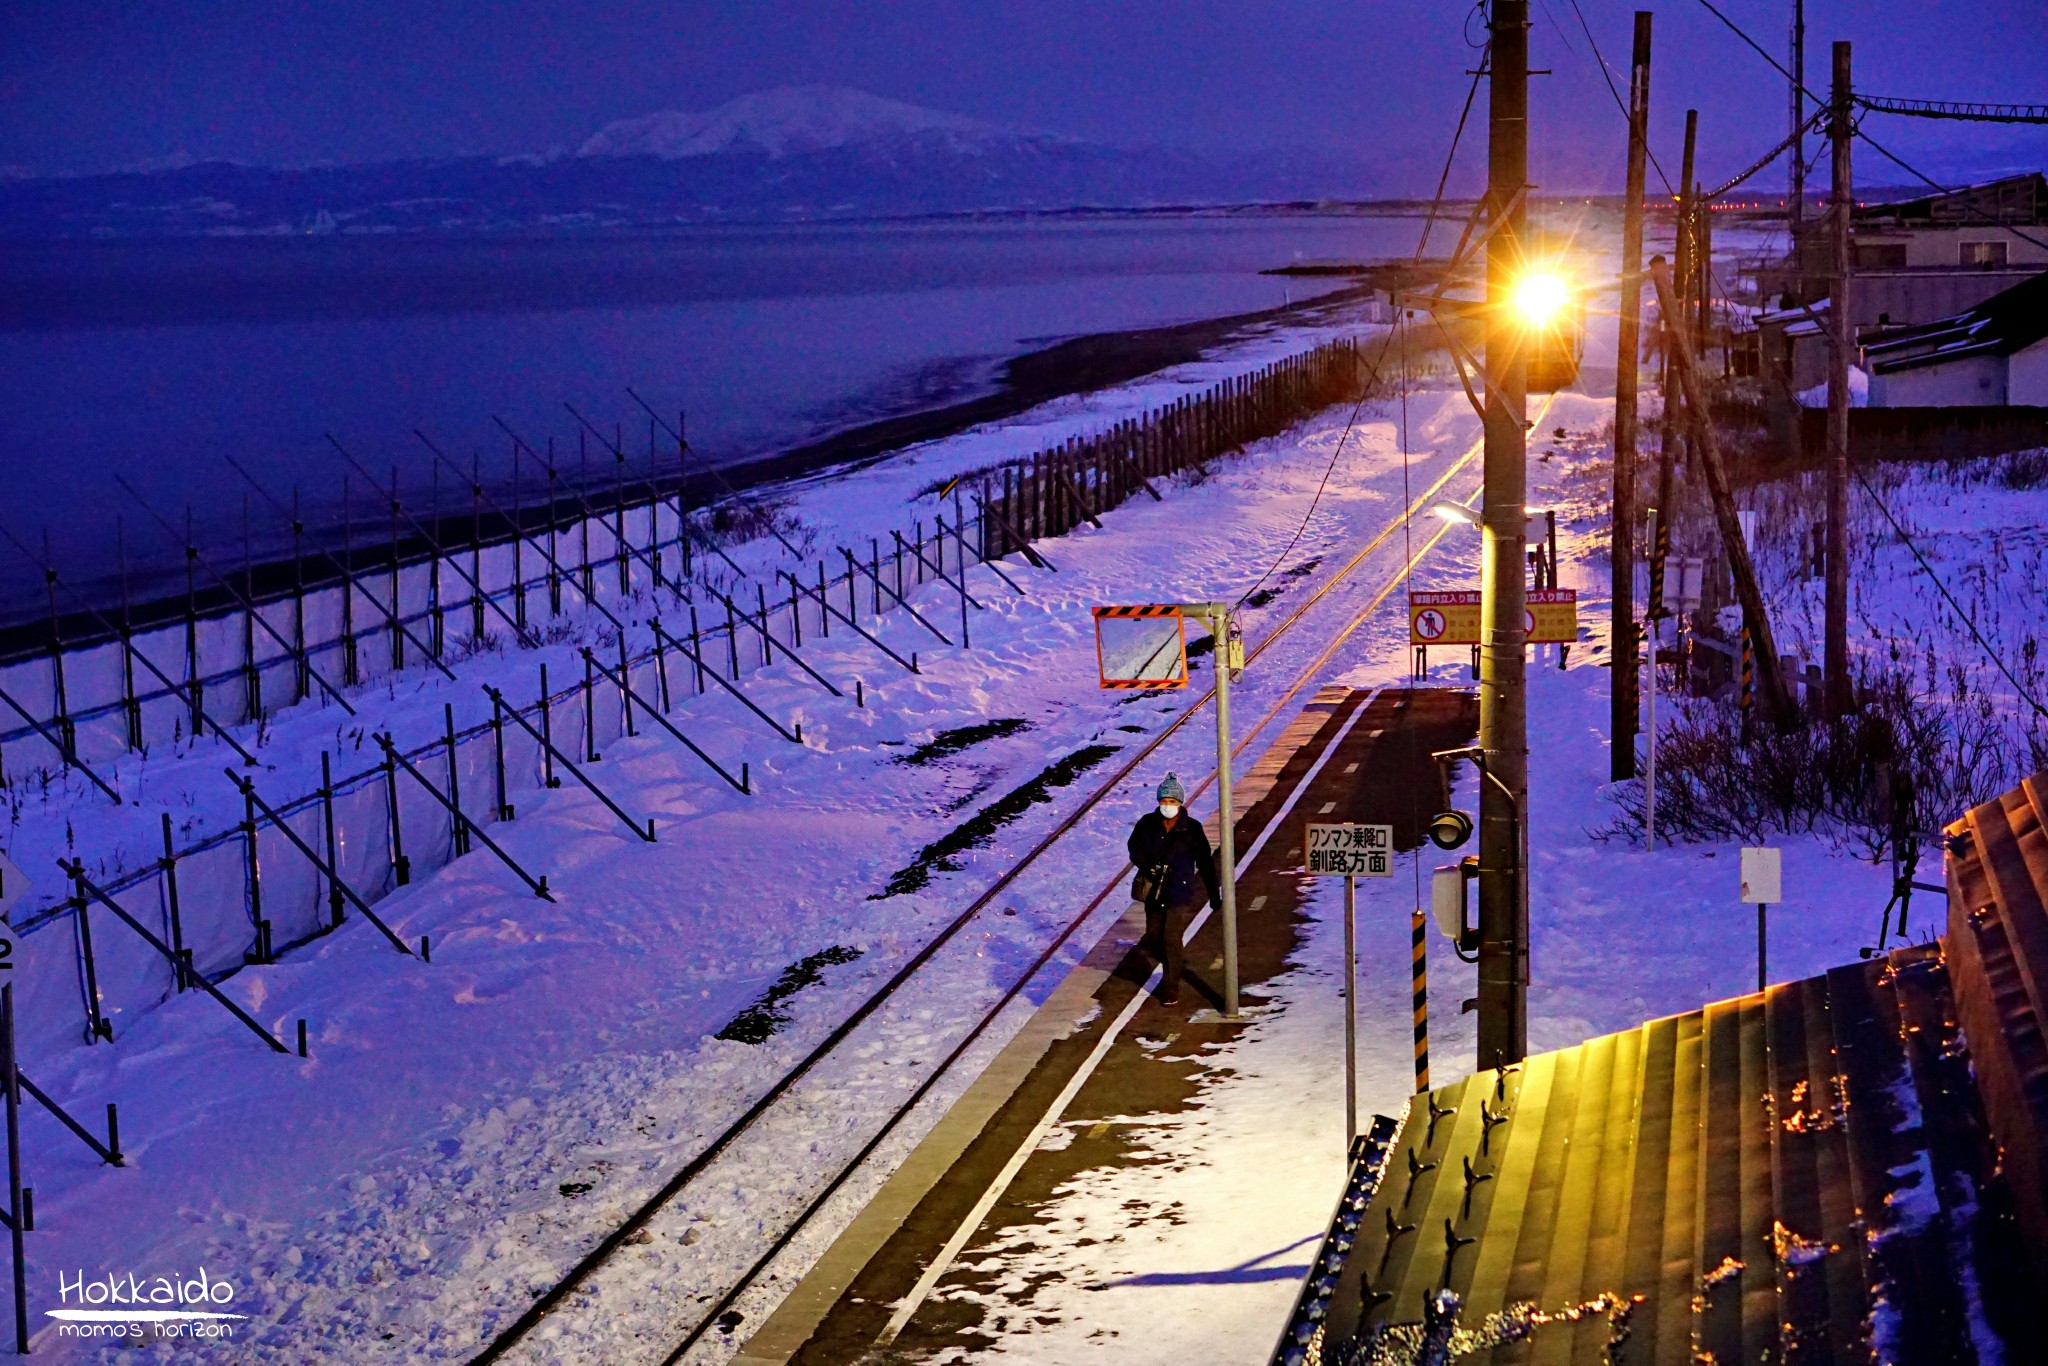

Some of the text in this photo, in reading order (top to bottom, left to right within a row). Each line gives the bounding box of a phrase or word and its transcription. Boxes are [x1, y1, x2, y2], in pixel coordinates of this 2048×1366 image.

[1310, 827, 1386, 849] ワンマン乗降口
[1309, 849, 1387, 873] 釧路方面
